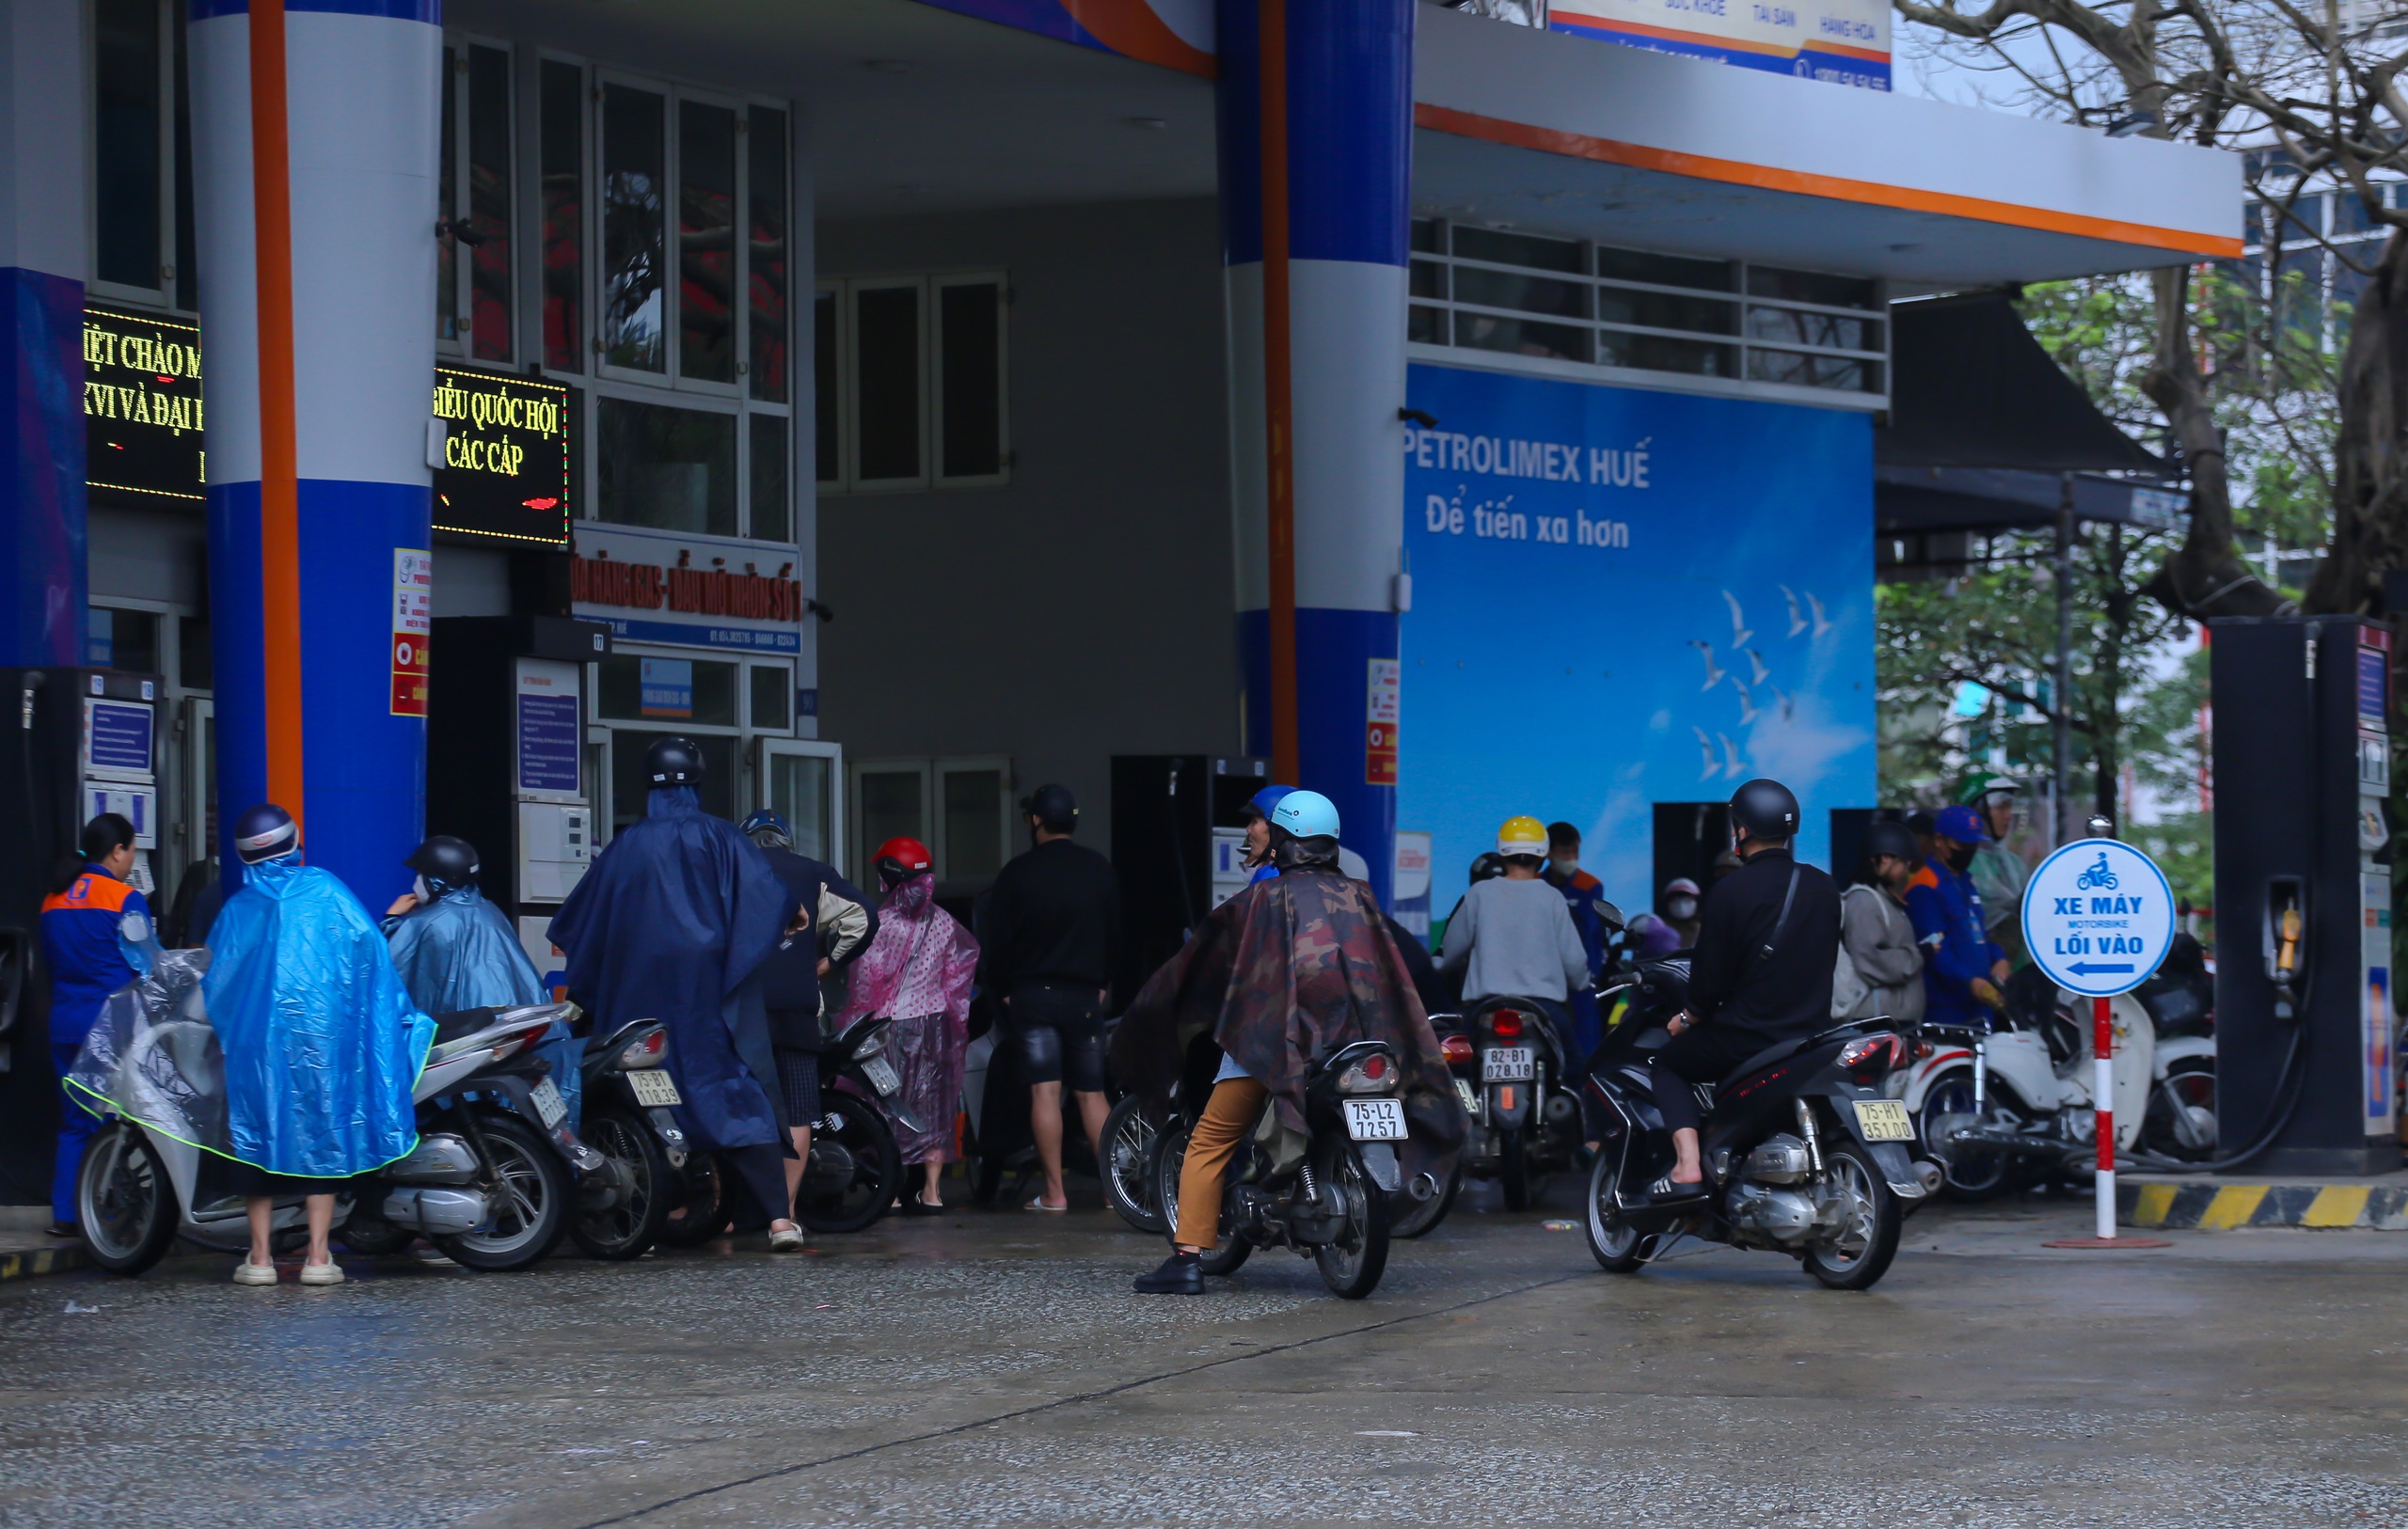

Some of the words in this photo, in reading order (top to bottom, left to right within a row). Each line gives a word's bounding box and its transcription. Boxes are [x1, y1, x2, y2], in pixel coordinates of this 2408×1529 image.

[120, 332, 183, 376] CHÀO
[118, 381, 151, 423] VÀ
[152, 391, 191, 436] ĐẠI
[471, 386, 522, 431] QUỐC
[525, 396, 558, 440] HỘI
[446, 430, 483, 470] CÁC
[487, 433, 523, 476] CẤP
[1404, 428, 1581, 483] PETROLIMEX
[1590, 436, 1653, 489] HUẾ
[1425, 483, 1466, 535] Để
[1473, 494, 1528, 541] tiến
[1535, 514, 1569, 544] xa
[1576, 509, 1630, 549] hơn
[594, 635, 602, 649] 17
[2053, 897, 2083, 915] XE
[2091, 893, 2143, 915] MÁY
[2067, 920, 2129, 929] MOTORBIKE
[2054, 931, 2089, 955] LỐI
[2098, 933, 2144, 954] VÀO
[1491, 1049, 1525, 1063] 82-B1
[634, 1072, 667, 1087] 75-B1
[640, 1088, 678, 1104] 118.39
[1352, 1103, 1395, 1120] 75-L2
[1861, 1103, 1899, 1120] 75-H1
[1355, 1121, 1397, 1138] 7257
[1863, 1122, 1910, 1139] 351.00
